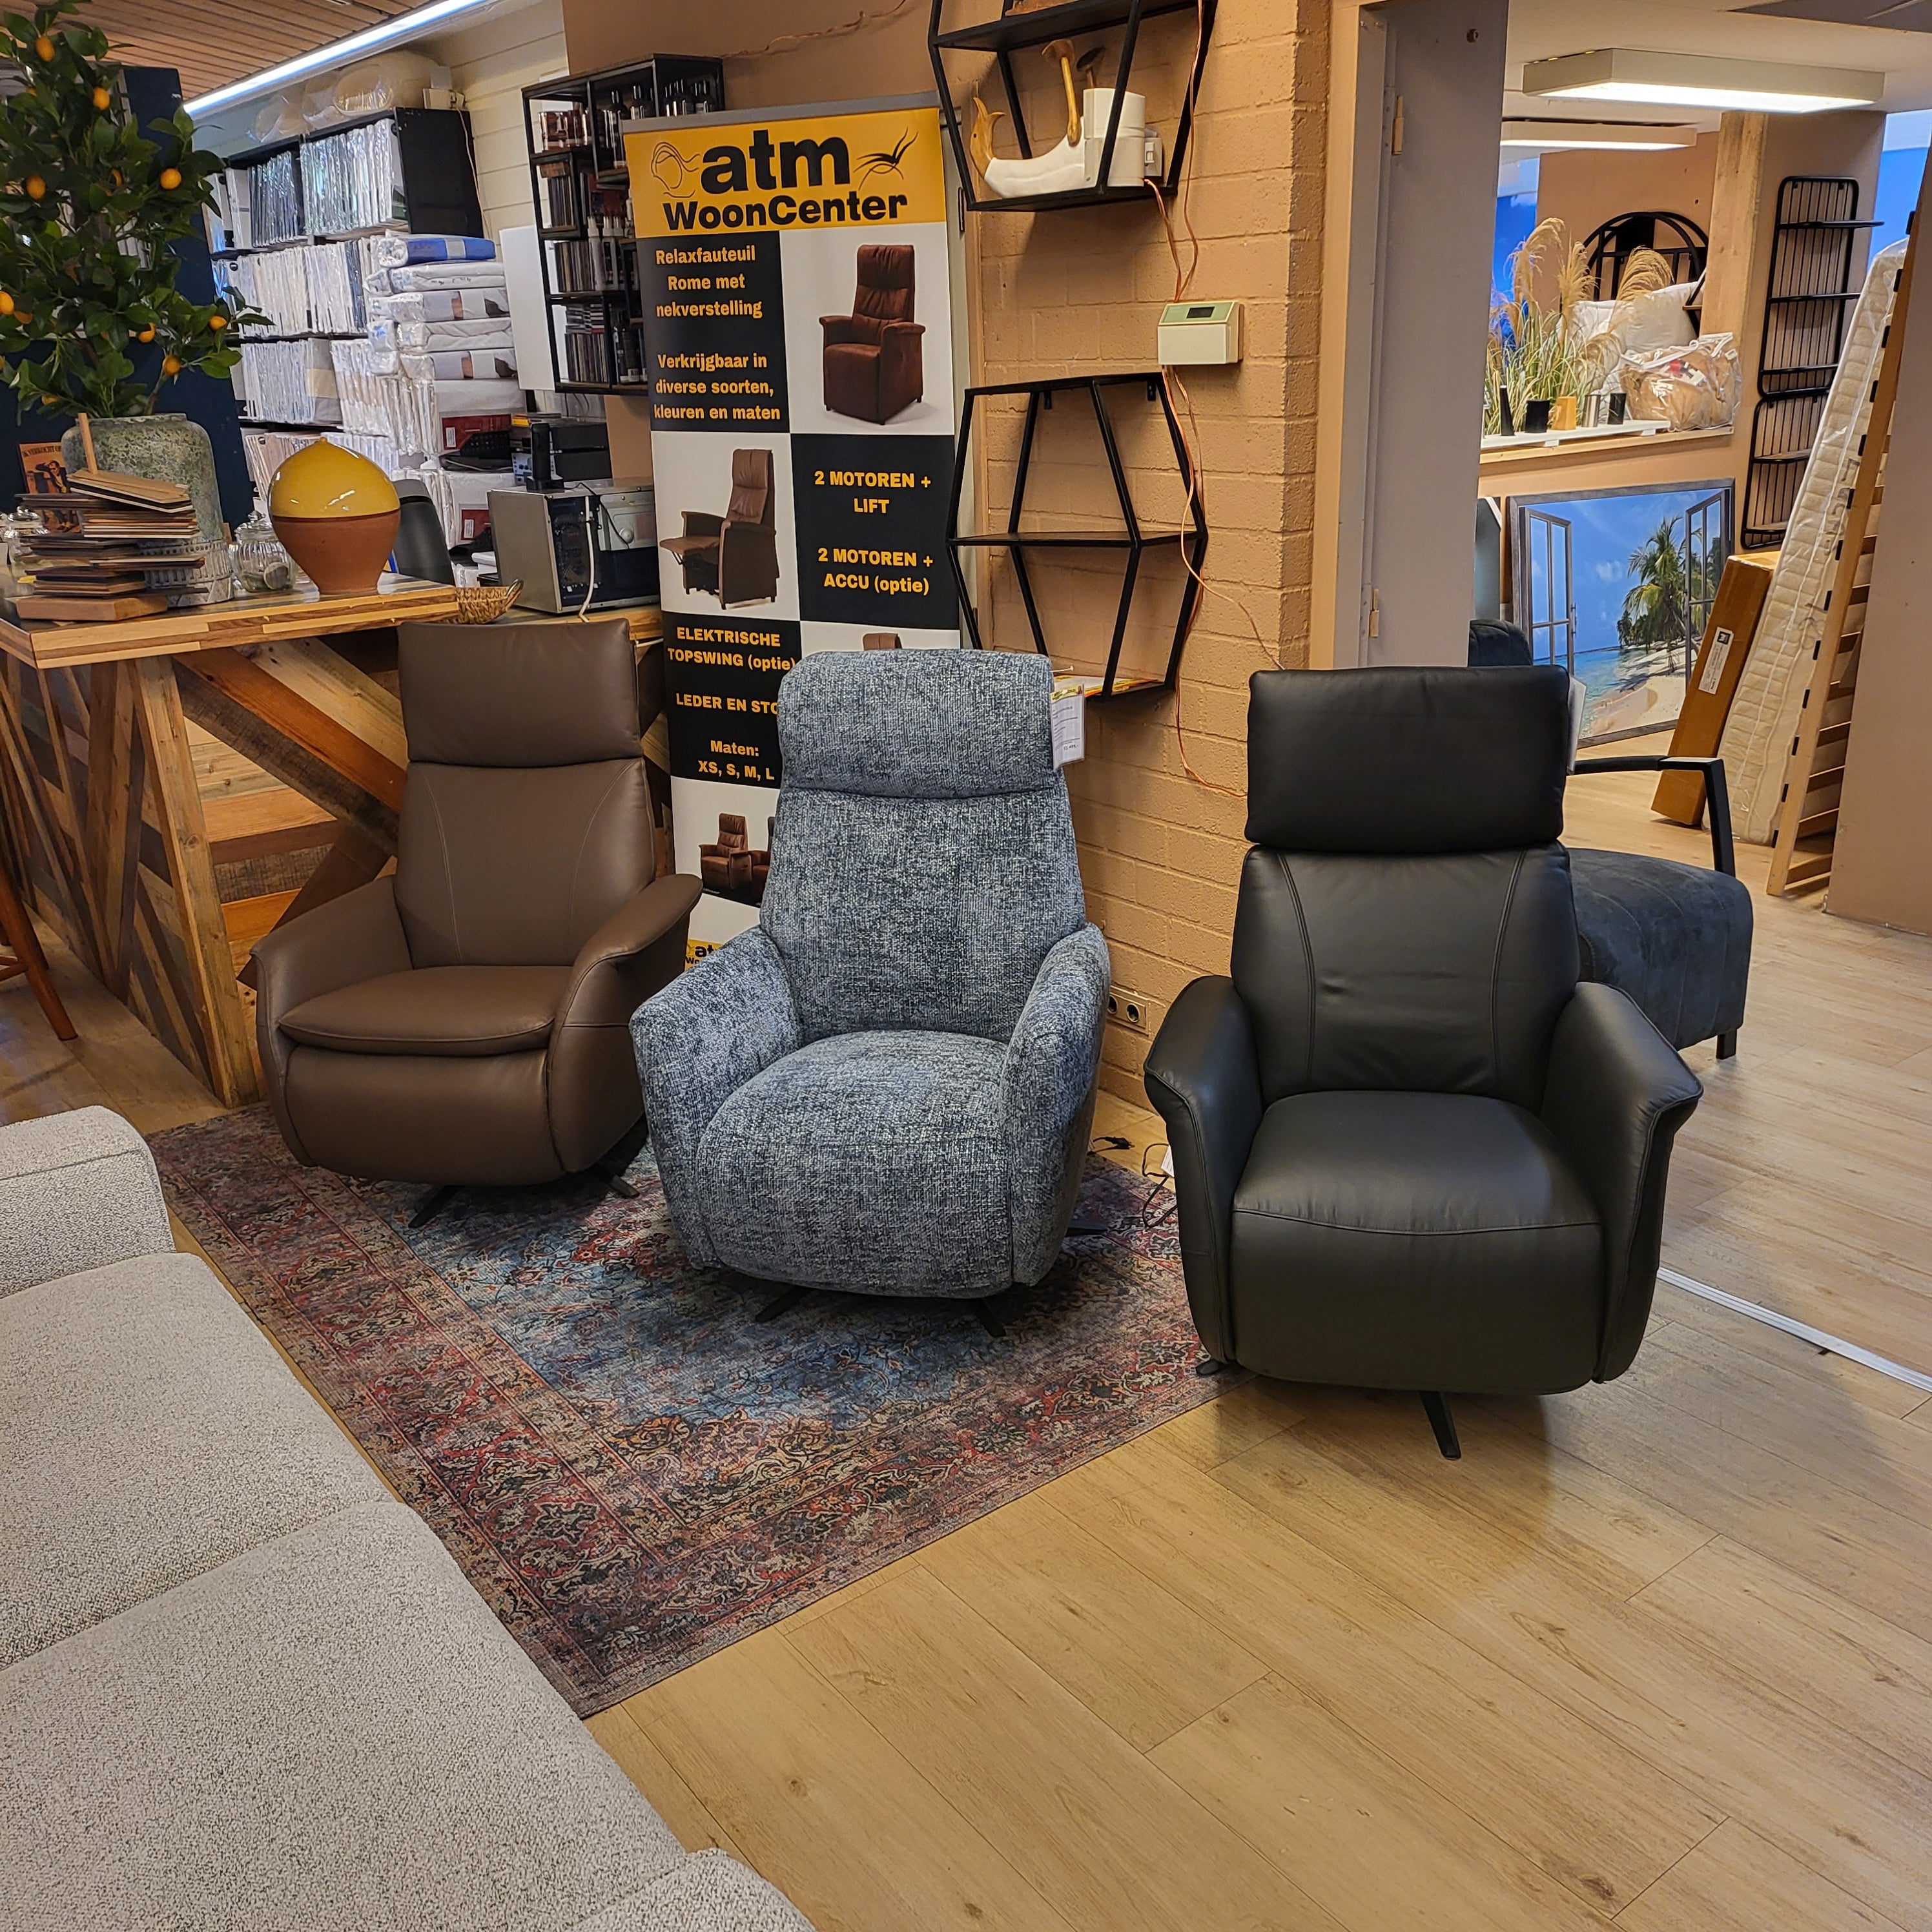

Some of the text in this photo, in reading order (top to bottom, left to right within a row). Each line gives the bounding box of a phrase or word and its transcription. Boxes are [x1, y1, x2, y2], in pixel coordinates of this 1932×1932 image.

[701, 129, 850, 194] atm
[663, 191, 907, 231] WoonCenter
[655, 245, 755, 265] Relaxfauteuil
[668, 273, 745, 291] Rome met
[656, 300, 763, 319] nekverstelling
[657, 353, 767, 372] Verkrijgbaar in
[655, 378, 774, 396] diverse soorten,
[653, 405, 781, 420] kleuren en maten
[814, 470, 931, 488] 2 MOTOREN +
[854, 498, 890, 513] LIFT
[817, 548, 933, 567] 2 MOTOREN +
[823, 573, 929, 596] ACCU (optie)
[677, 626, 781, 647] ELEKTRISCHE
[667, 648, 743, 666] TOPSWING
[676, 693, 723, 709] LEDER
[726, 697, 747, 712] EN
[710, 740, 759, 757] Maten:
[698, 760, 774, 780] XS, S, M, L
[695, 945, 714, 958] at
